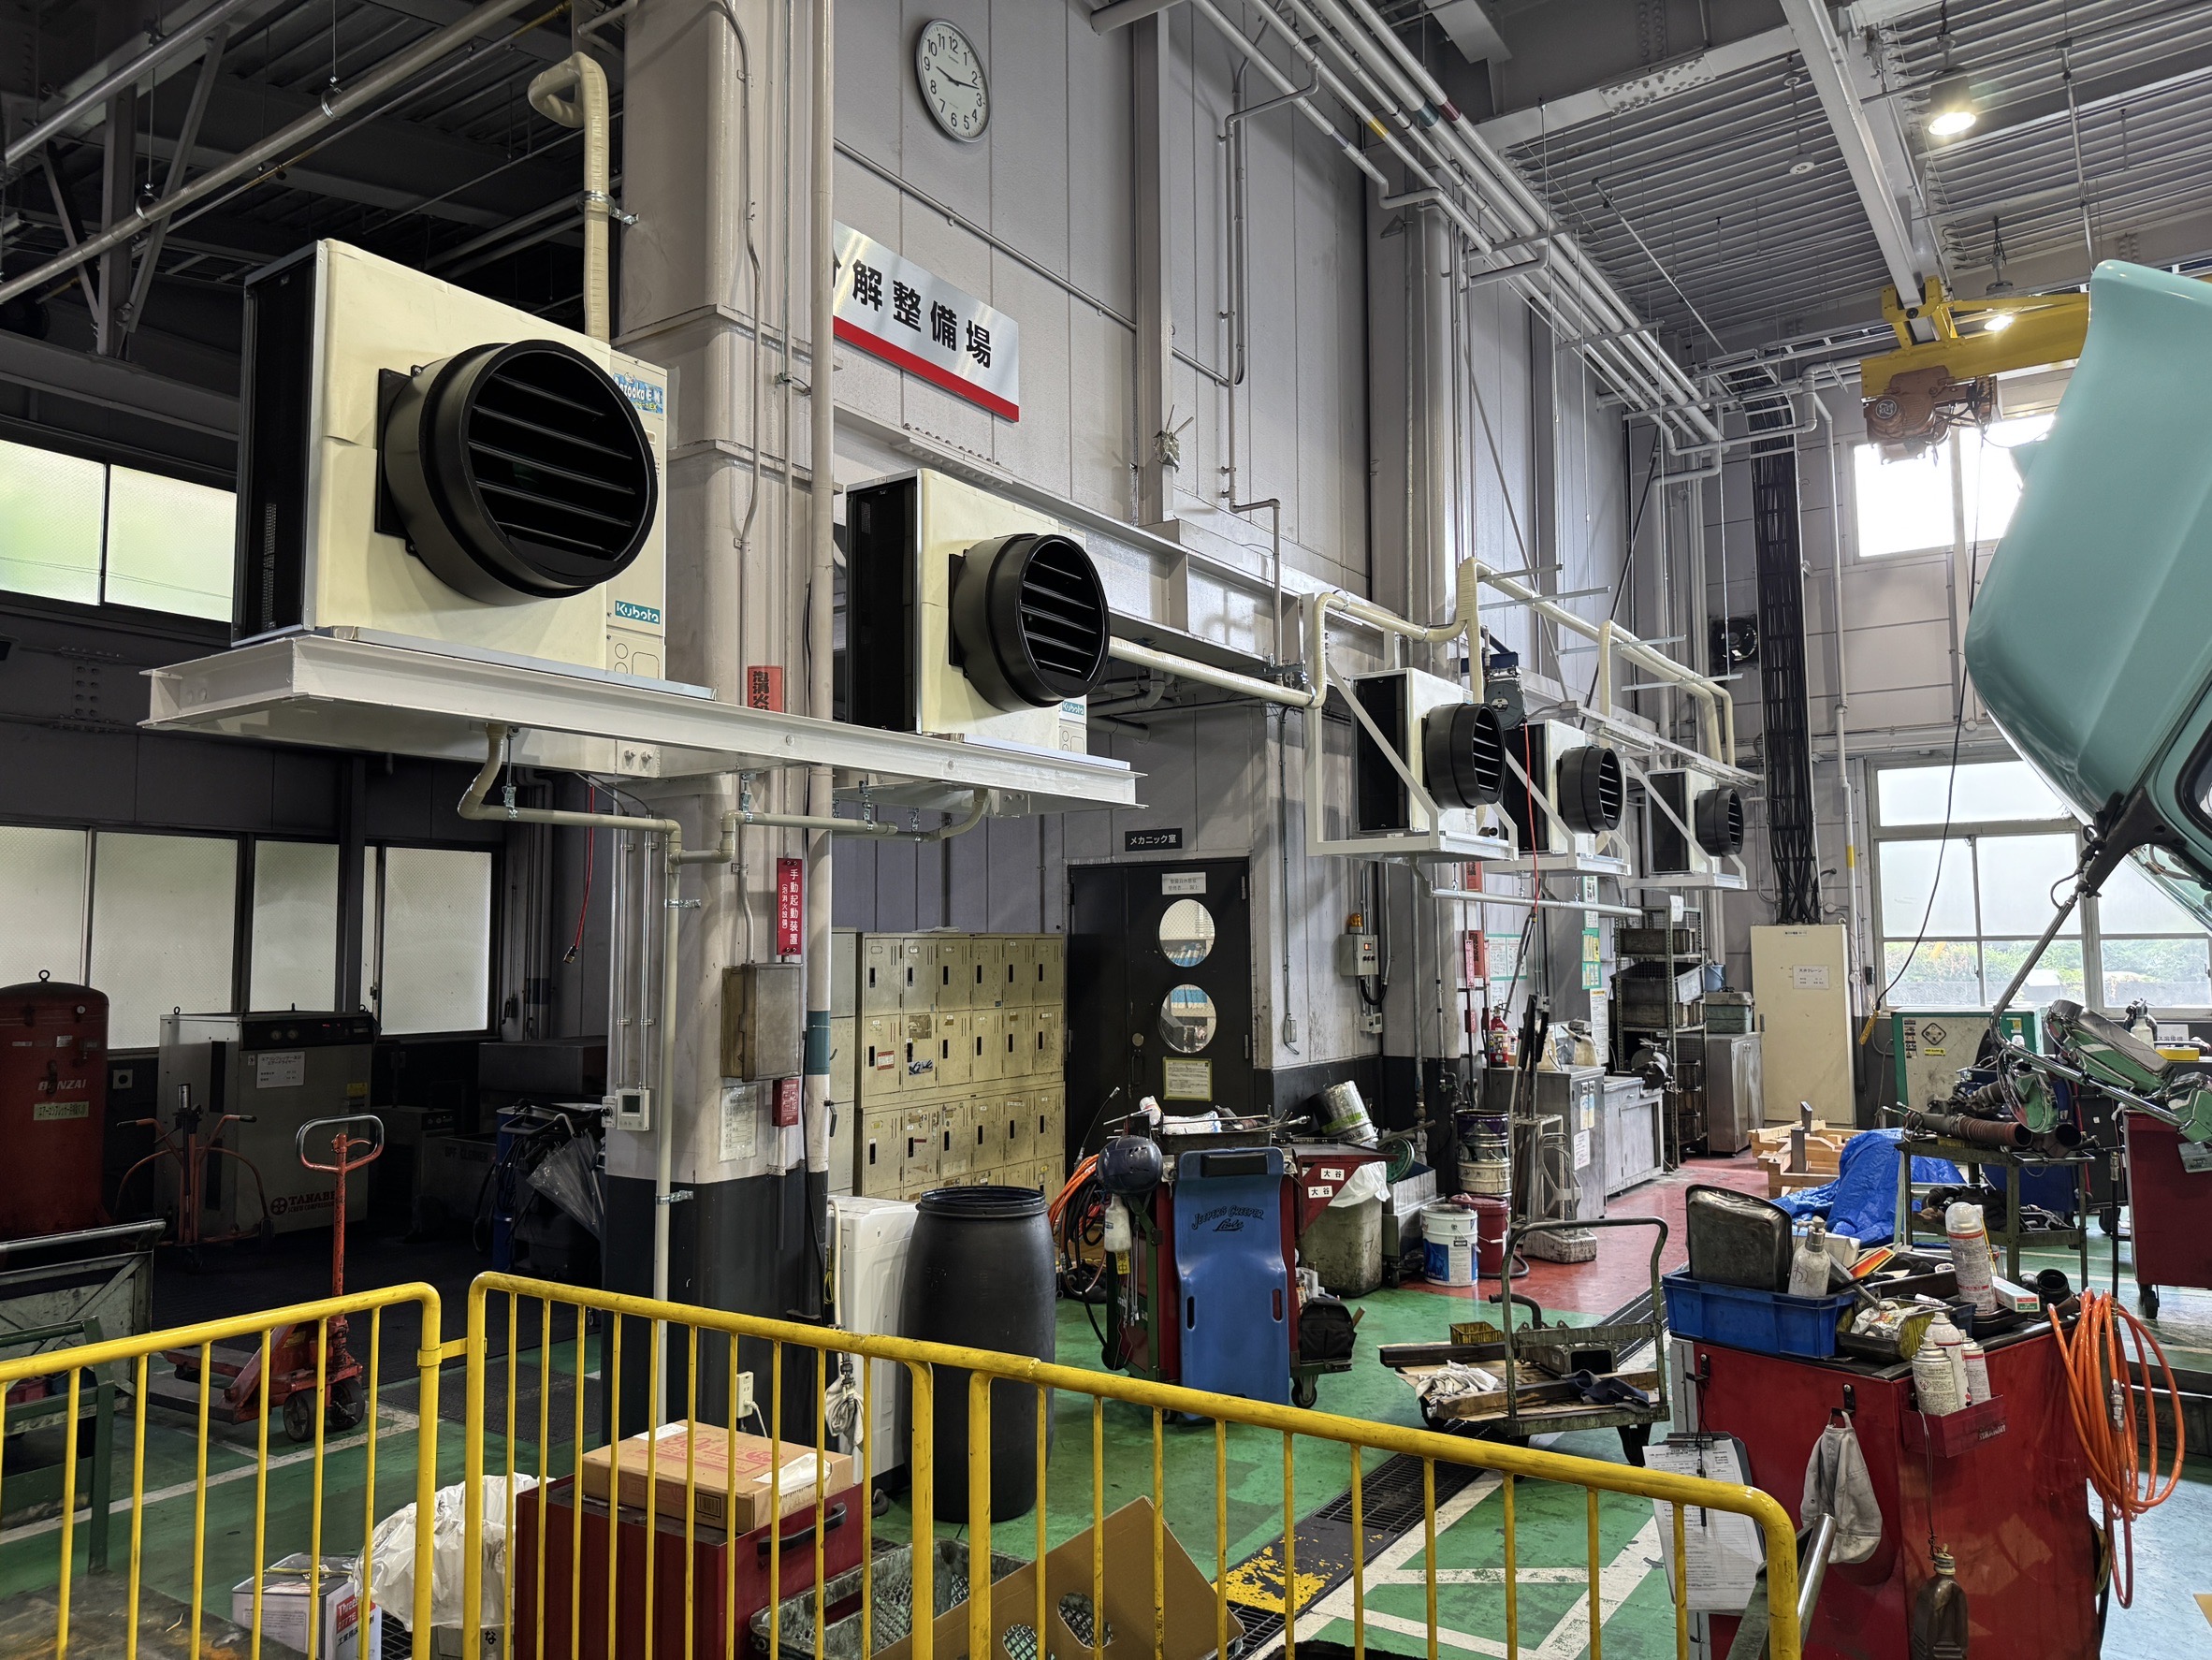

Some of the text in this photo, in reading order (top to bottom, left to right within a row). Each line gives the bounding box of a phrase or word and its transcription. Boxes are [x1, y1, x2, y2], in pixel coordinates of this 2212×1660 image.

[927, 39, 937, 56] 10
[938, 34, 945, 50] 11
[949, 36, 959, 54] 12
[924, 56, 930, 71] 9
[964, 51, 968, 66] 1
[971, 71, 978, 86] 2
[930, 80, 937, 95] 8
[939, 98, 945, 113] 7
[976, 93, 982, 107] 3
[951, 112, 957, 127] 6
[963, 115, 969, 130] 5
[971, 109, 977, 123] 4
[617, 603, 659, 622] Kubota
[1063, 702, 1084, 715] Kubota
[1130, 834, 1176, 845] メカニック室
[790, 868, 799, 945] 手動起動装置
[37, 1079, 87, 1091] BNZAI
[1324, 1170, 1342, 1178] 大谷
[1311, 1187, 1330, 1196] 大谷
[1191, 1204, 1264, 1230] JEEPERS CREEPER
[485, 1630, 497, 1645] な
